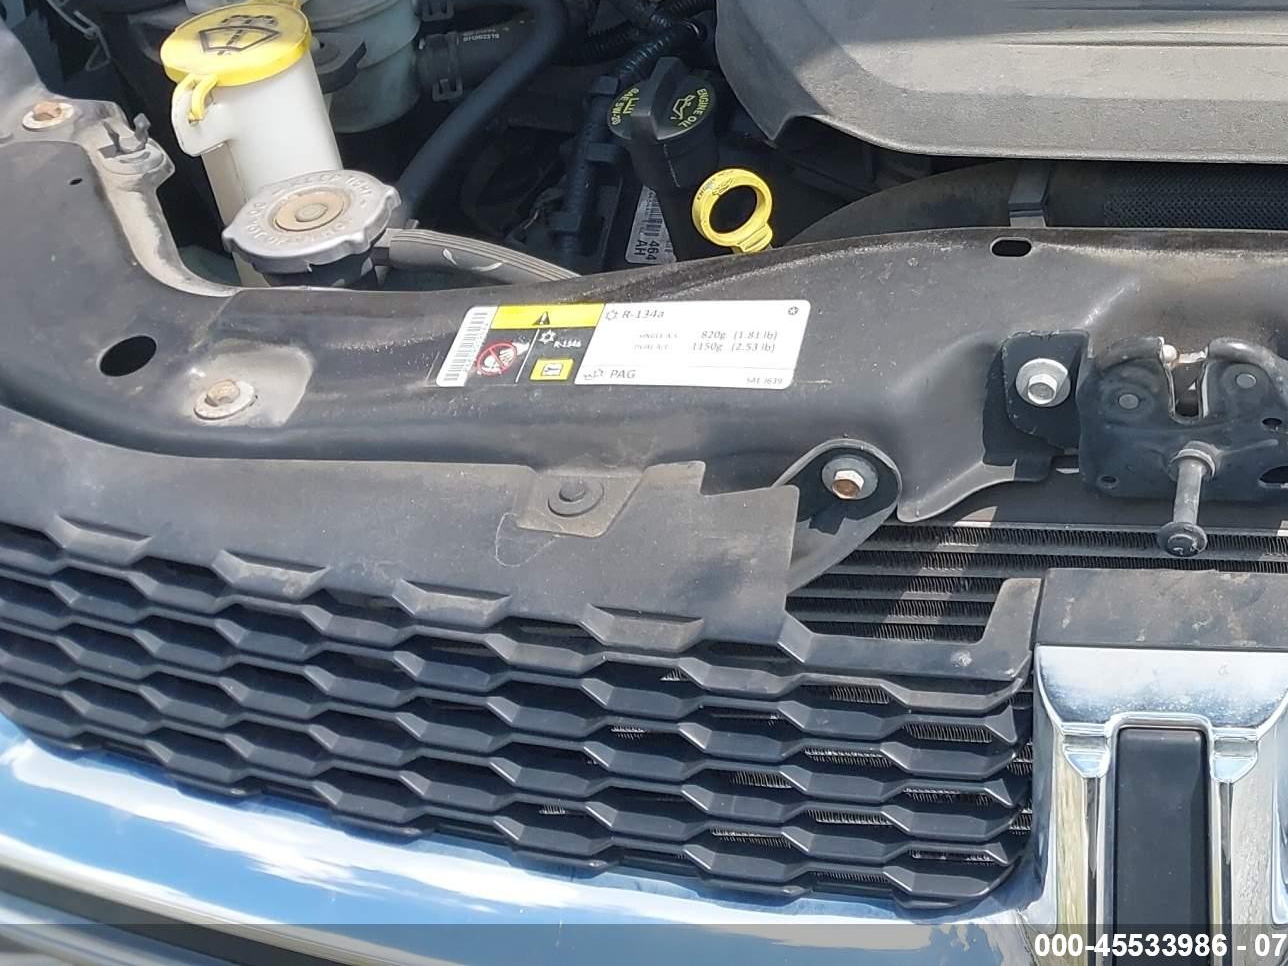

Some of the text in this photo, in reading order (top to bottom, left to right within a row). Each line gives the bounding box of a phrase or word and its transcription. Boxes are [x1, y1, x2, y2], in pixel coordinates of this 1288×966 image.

[678, 88, 709, 128] ENGINE OIL
[634, 239, 646, 257] AH
[622, 309, 665, 319] R-134a
[609, 369, 637, 379] PAG
